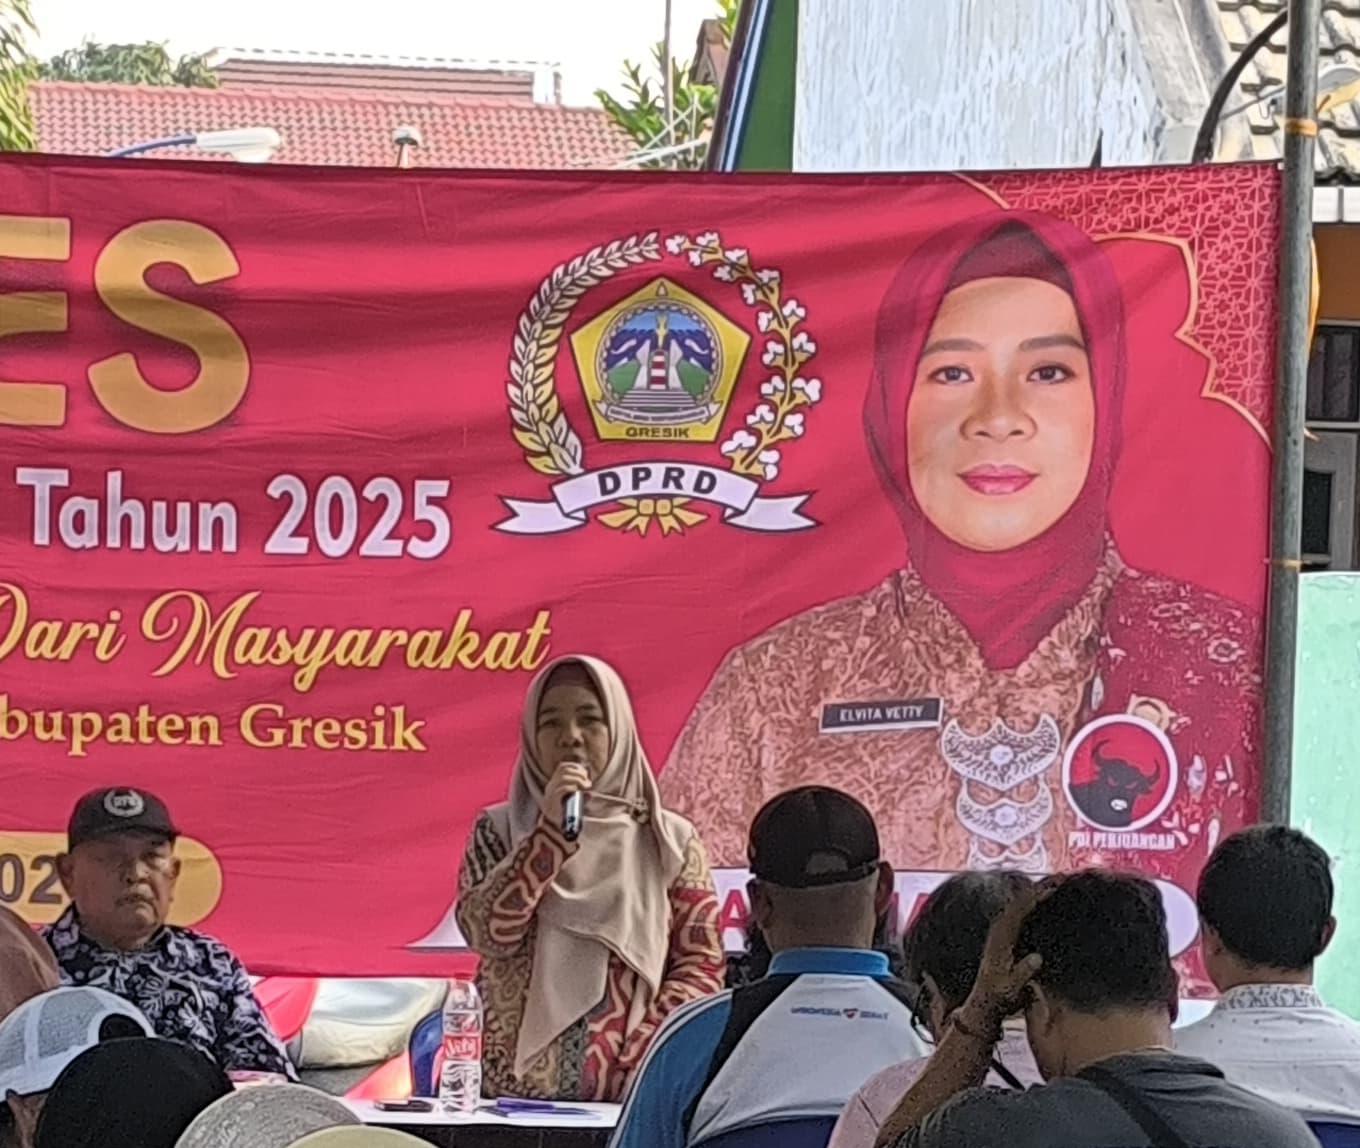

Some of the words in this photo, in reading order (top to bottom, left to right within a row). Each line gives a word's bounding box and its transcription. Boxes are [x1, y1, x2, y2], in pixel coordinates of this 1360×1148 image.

[625, 426, 691, 439] GRESIK
[597, 466, 718, 497] DPRD
[15, 467, 238, 553] Tahun
[263, 474, 451, 559] 2025
[142, 590, 551, 693] Masyarakat
[240, 703, 427, 751] Gresik
[839, 707, 882, 722] ELVITA
[1068, 831, 1091, 848] PDI
